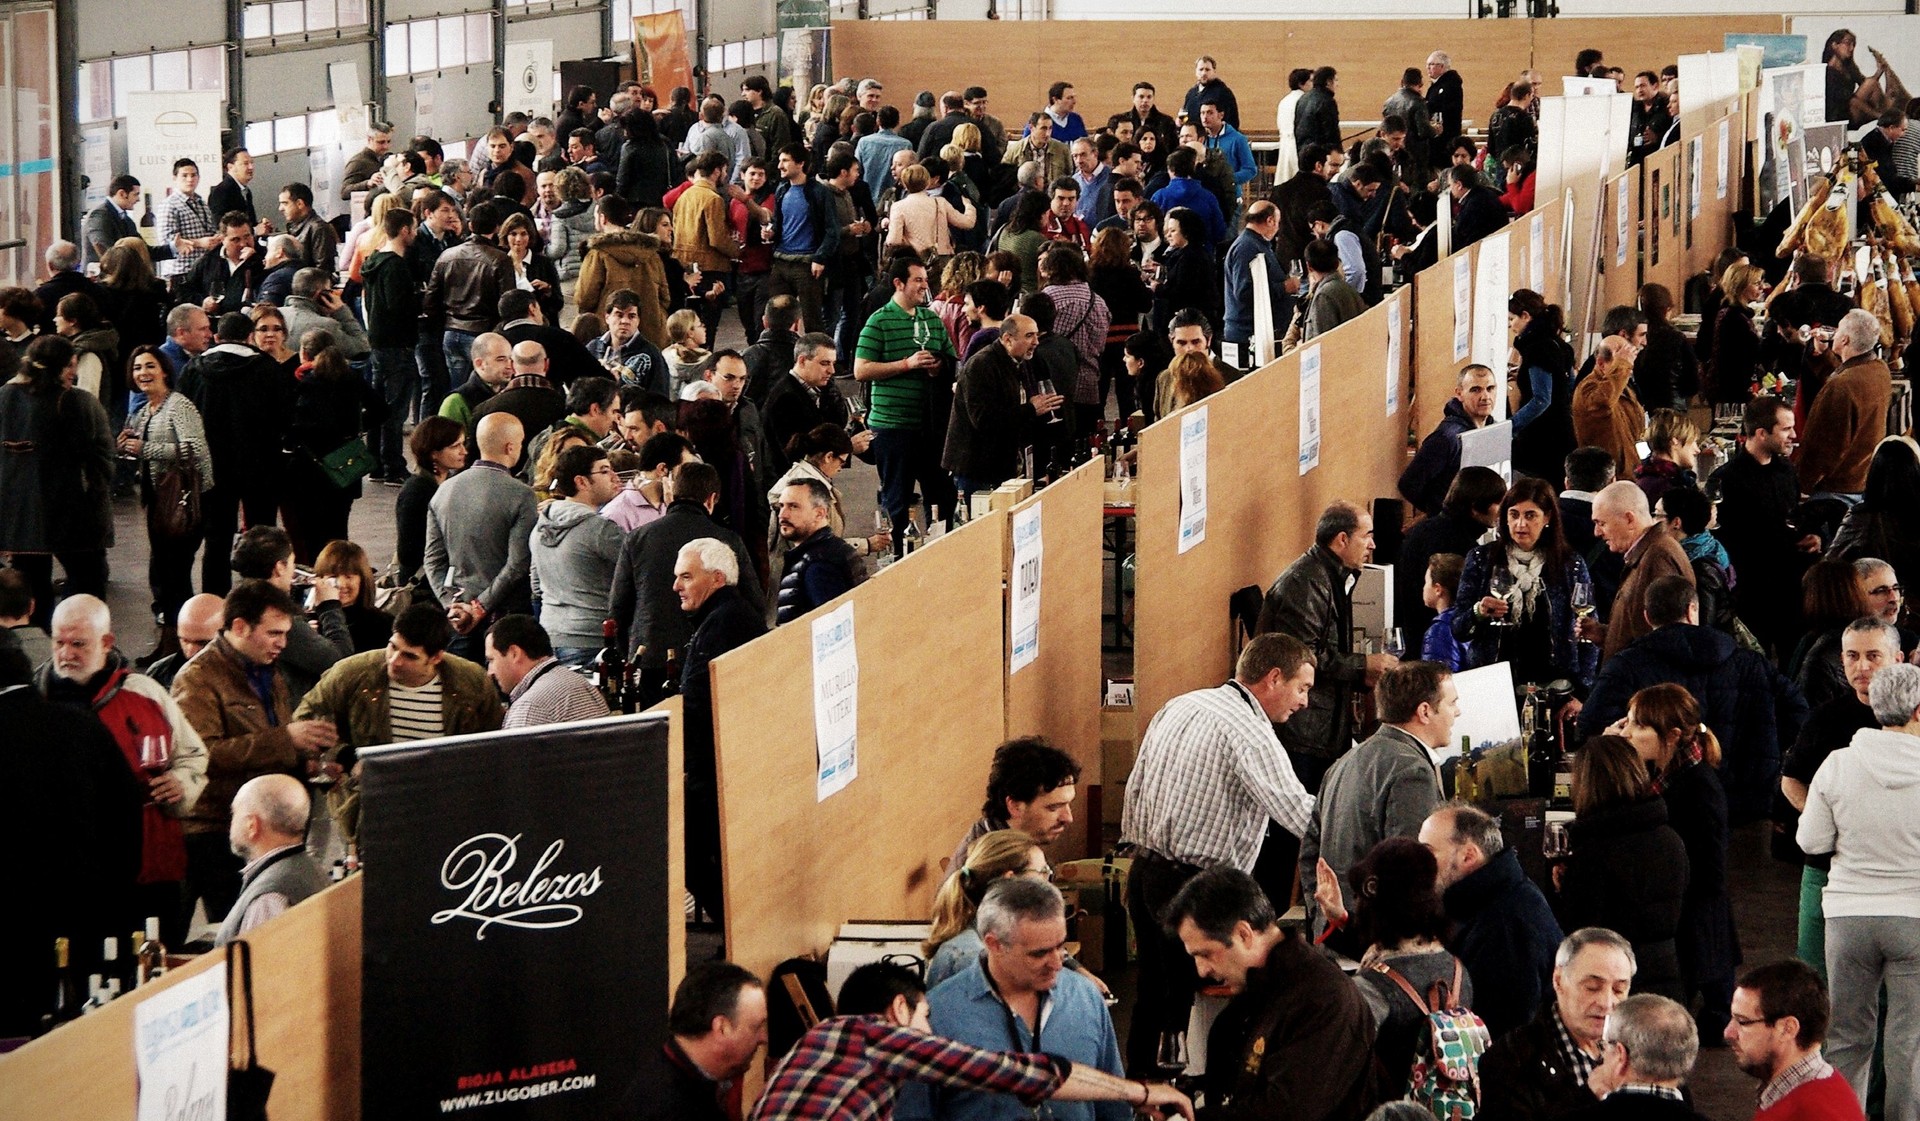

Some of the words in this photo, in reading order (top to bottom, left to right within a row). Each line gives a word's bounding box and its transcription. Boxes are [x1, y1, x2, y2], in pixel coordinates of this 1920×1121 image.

[139, 155, 167, 166] LUIS
[820, 664, 857, 702] MURILLO
[826, 695, 853, 726] VITERI
[430, 832, 604, 942] Belezos
[457, 1071, 503, 1089] RIOJA
[509, 1058, 577, 1081] ALAVESA
[439, 1074, 597, 1113] WWW.ZUGOBER.COM
